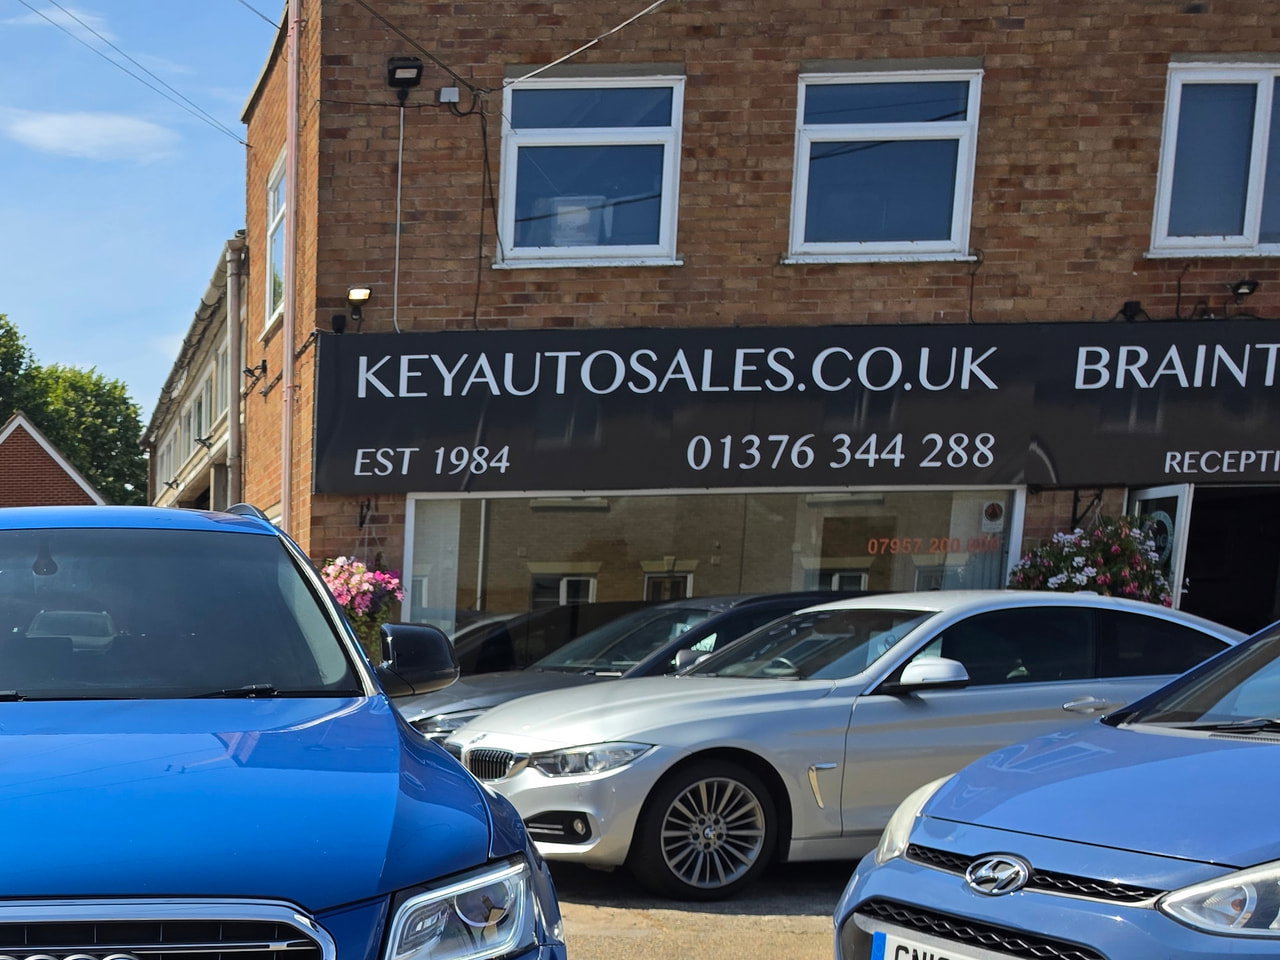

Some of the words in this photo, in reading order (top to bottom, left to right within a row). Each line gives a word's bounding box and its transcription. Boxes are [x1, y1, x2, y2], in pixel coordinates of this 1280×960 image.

[357, 346, 999, 399] KEYAUTOSALES.CO.UK
[1074, 343, 1280, 390] BRAINT
[353, 447, 420, 477] EST
[433, 444, 511, 476] 1984
[686, 433, 816, 471] 01376
[829, 432, 906, 469] 344
[918, 432, 996, 469] 288
[1163, 450, 1280, 474] RECEPTI
[867, 537, 923, 555] 07957
